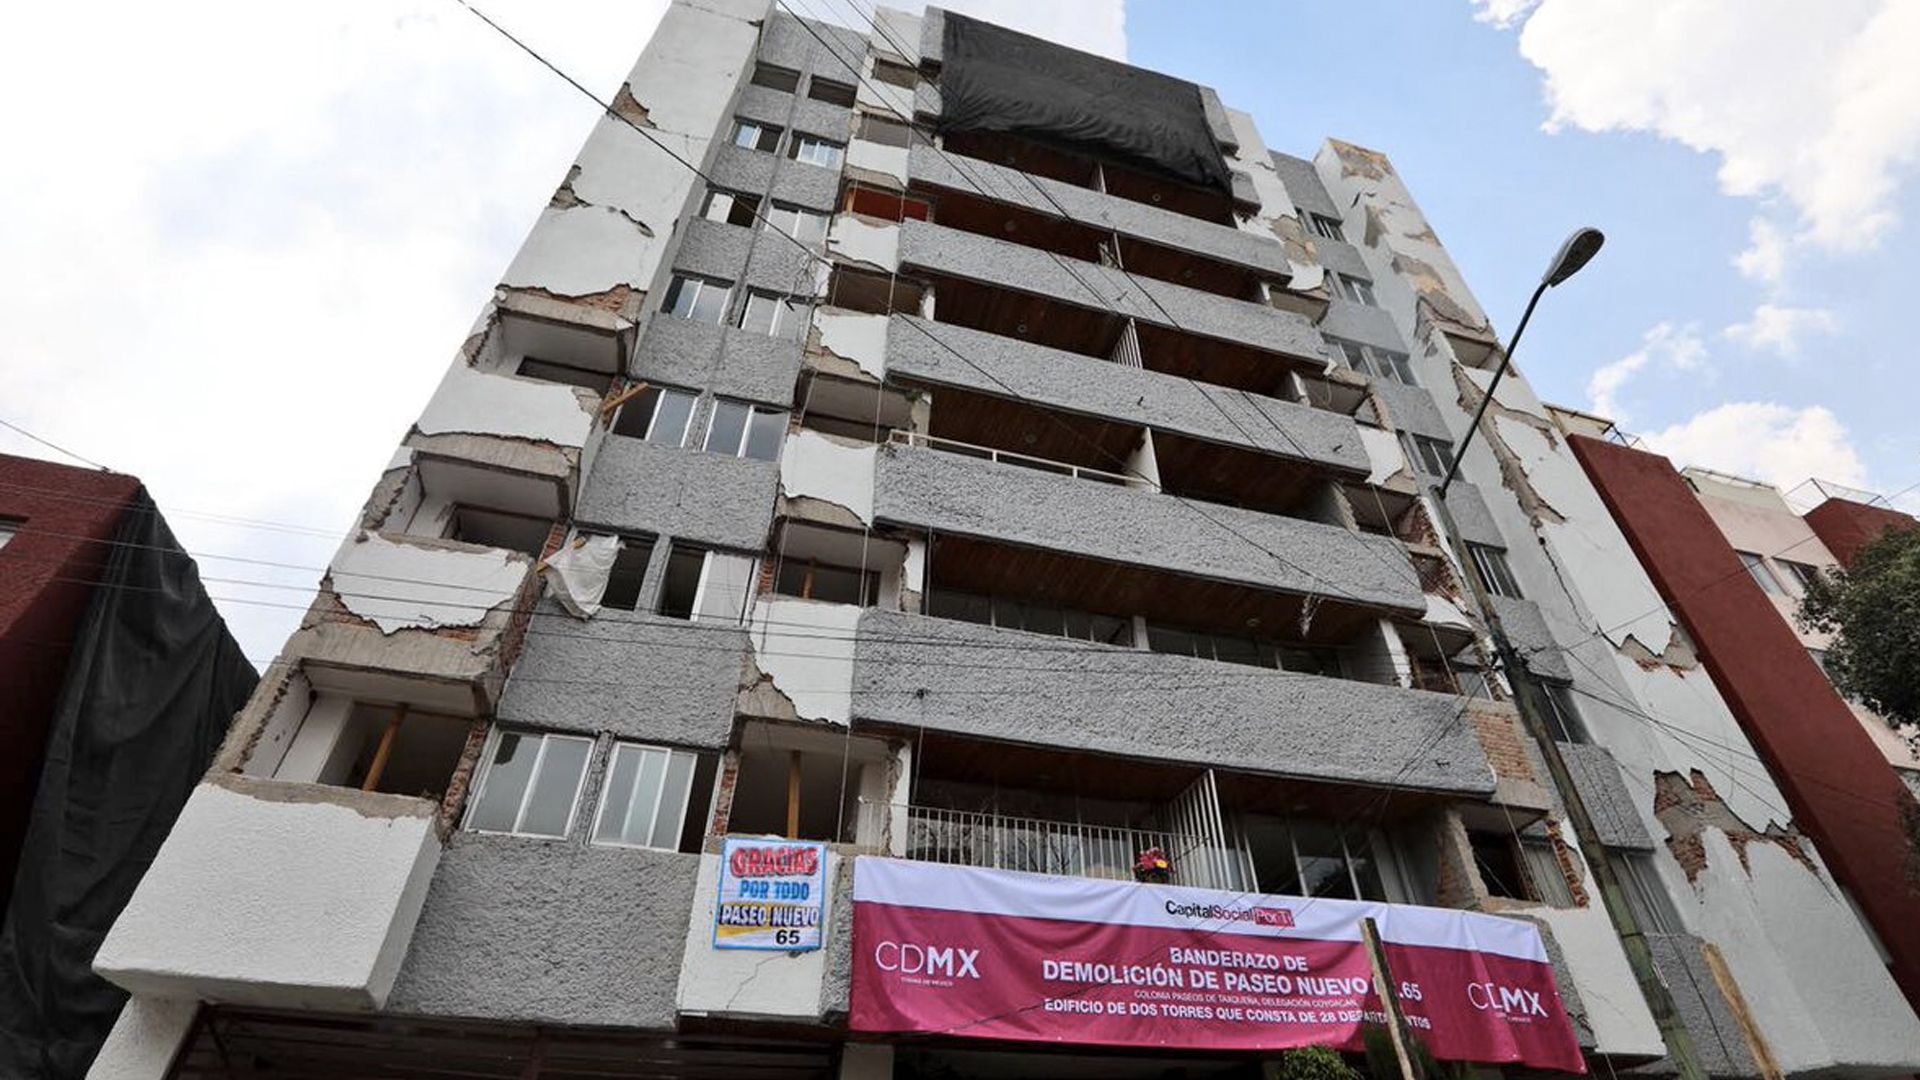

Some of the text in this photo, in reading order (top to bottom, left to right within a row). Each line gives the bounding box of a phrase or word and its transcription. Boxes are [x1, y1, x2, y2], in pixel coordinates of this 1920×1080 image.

[730, 847, 819, 878] GRACIAS
[739, 880, 810, 900] POR TODO
[720, 904, 820, 927] PASEO NUEVO
[775, 929, 800, 945] 65
[875, 941, 981, 979] CDMX
[1169, 946, 1309, 971] BANDERAZO DE
[1043, 960, 1184, 988] DEMOLICIÓN
[1189, 969, 1219, 989] DE
[1224, 972, 1292, 995] PASEO
[1296, 976, 1369, 996] NUEVO
[1044, 998, 1103, 1014] EDIFICIO
[1107, 1001, 1126, 1015] DE
[1130, 1003, 1157, 1017] DOS
[1161, 1004, 1213, 1019] TORRES
[1216, 1007, 1243, 1021] QUE
[1246, 1009, 1296, 1023] CONSTA
[1299, 1010, 1318, 1024] DE
[1320, 1011, 1337, 1024] 28
